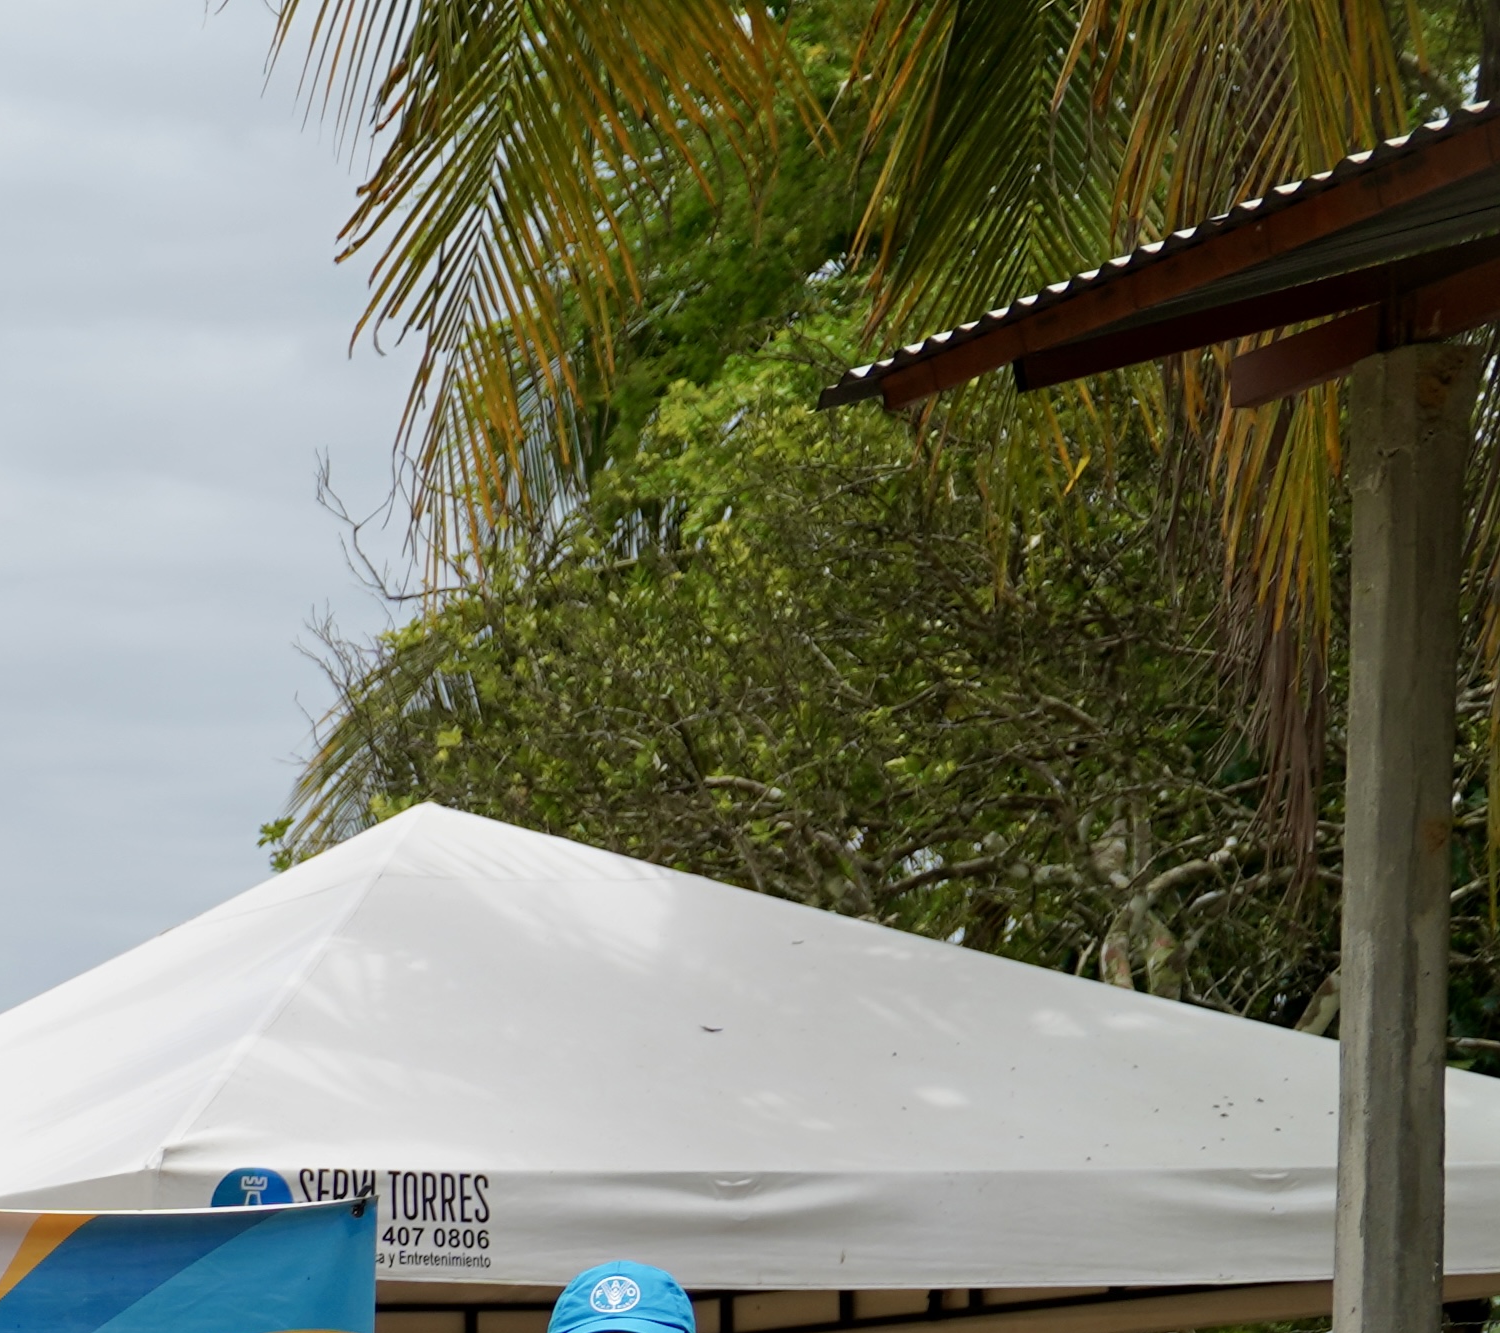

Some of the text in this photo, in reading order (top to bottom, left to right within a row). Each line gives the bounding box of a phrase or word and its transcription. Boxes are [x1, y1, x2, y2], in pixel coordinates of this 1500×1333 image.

[387, 1170, 490, 1223] TORRES
[382, 1226, 489, 1249] 407 0806
[388, 1253, 395, 1266] y
[398, 1250, 491, 1268] Entretenimiento
